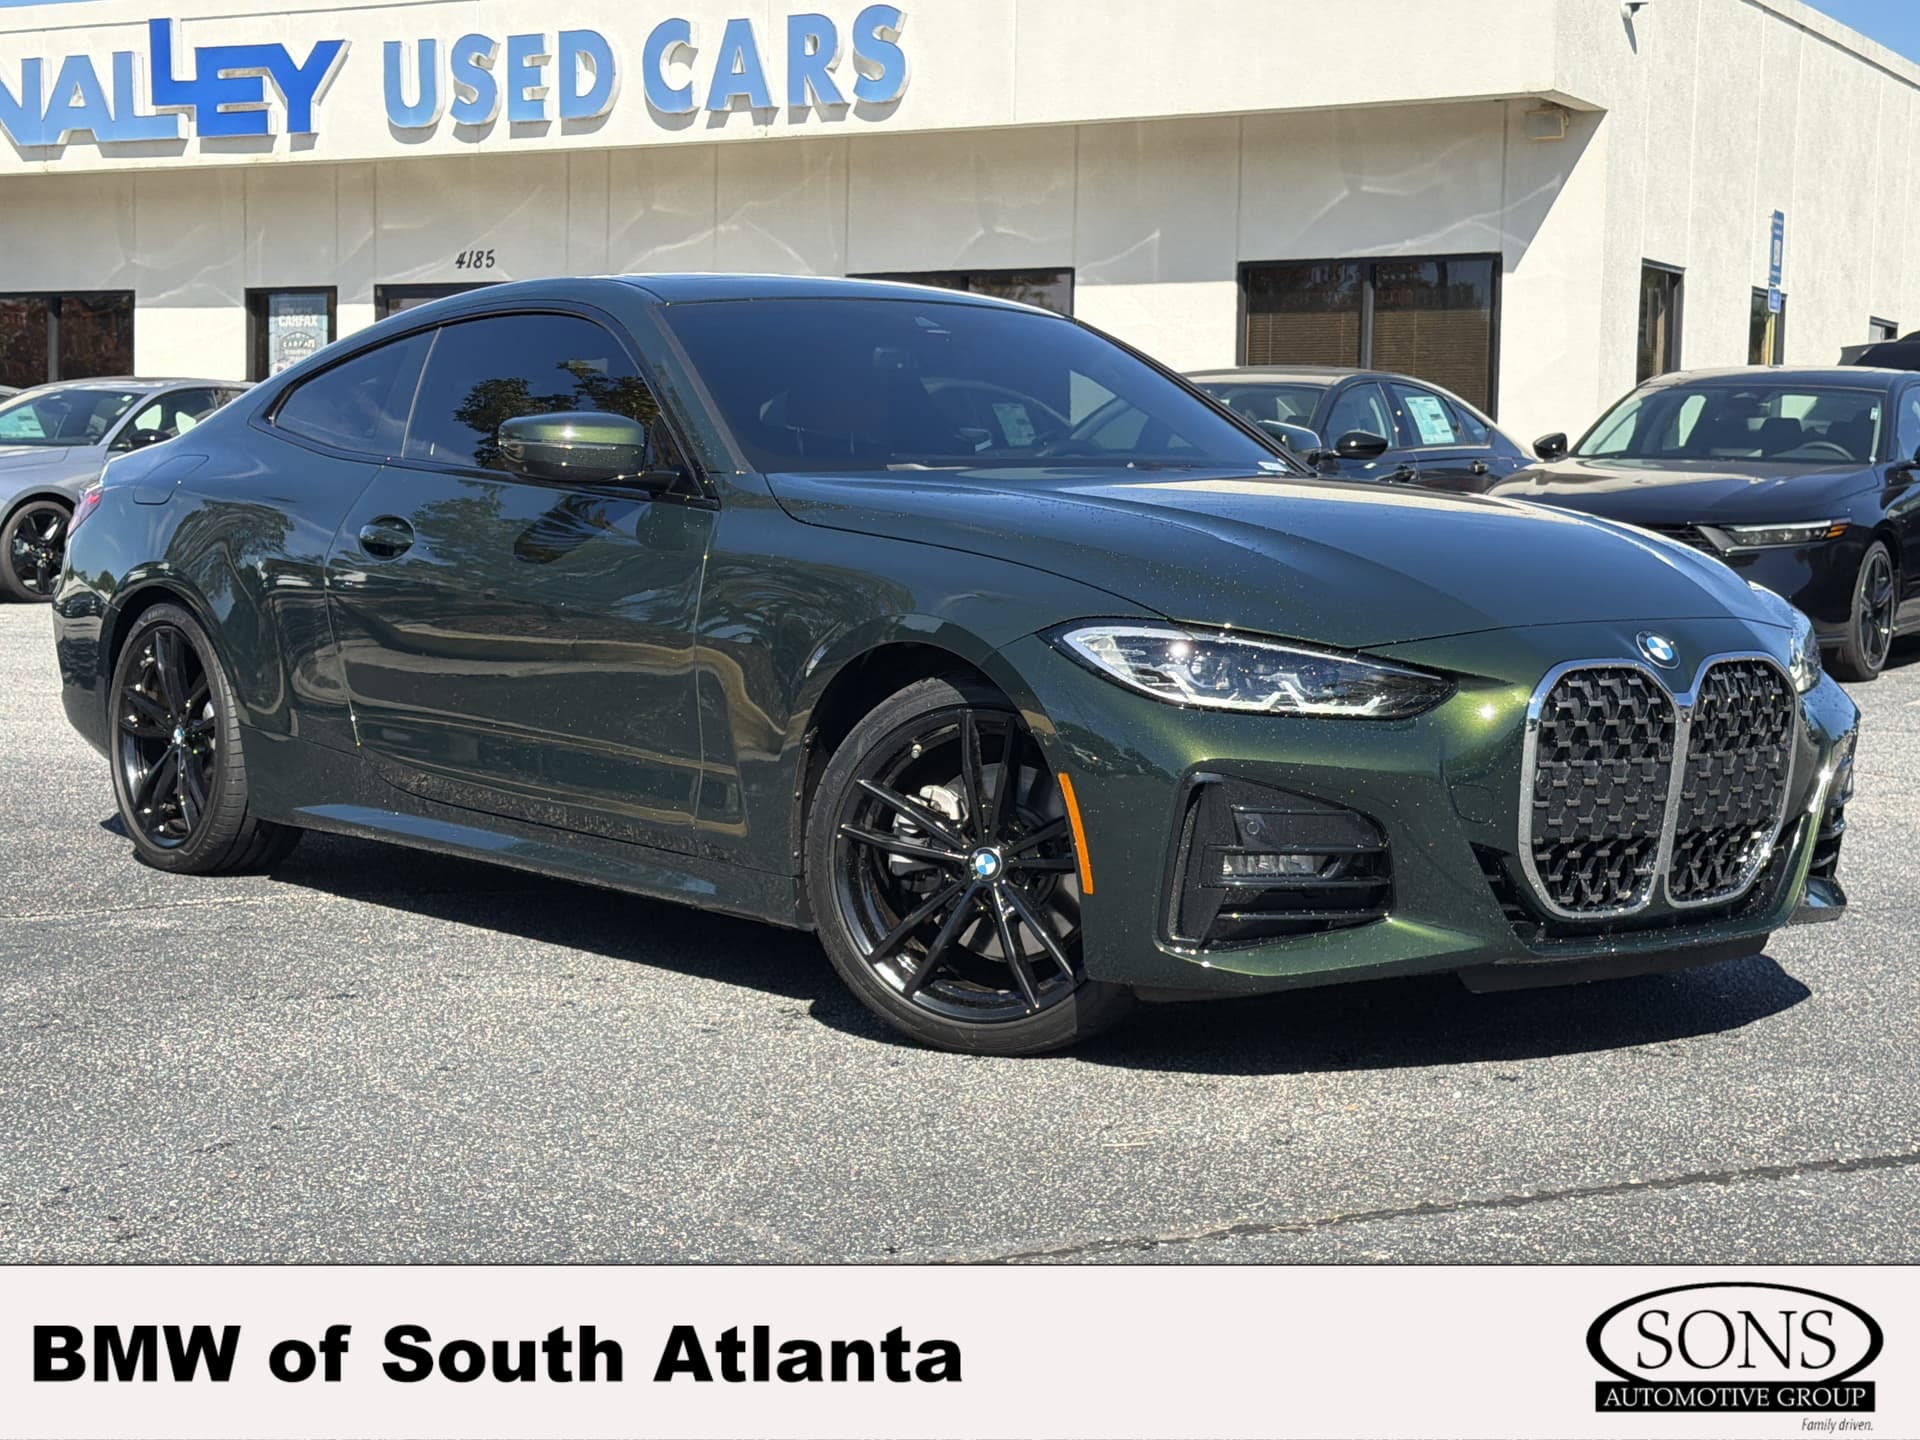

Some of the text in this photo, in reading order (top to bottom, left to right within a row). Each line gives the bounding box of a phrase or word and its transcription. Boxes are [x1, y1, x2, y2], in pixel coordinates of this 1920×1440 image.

[383, 29, 619, 128] USED
[643, 4, 908, 114] CARS
[455, 249, 495, 269] 4185
[279, 314, 318, 328] CARFAX
